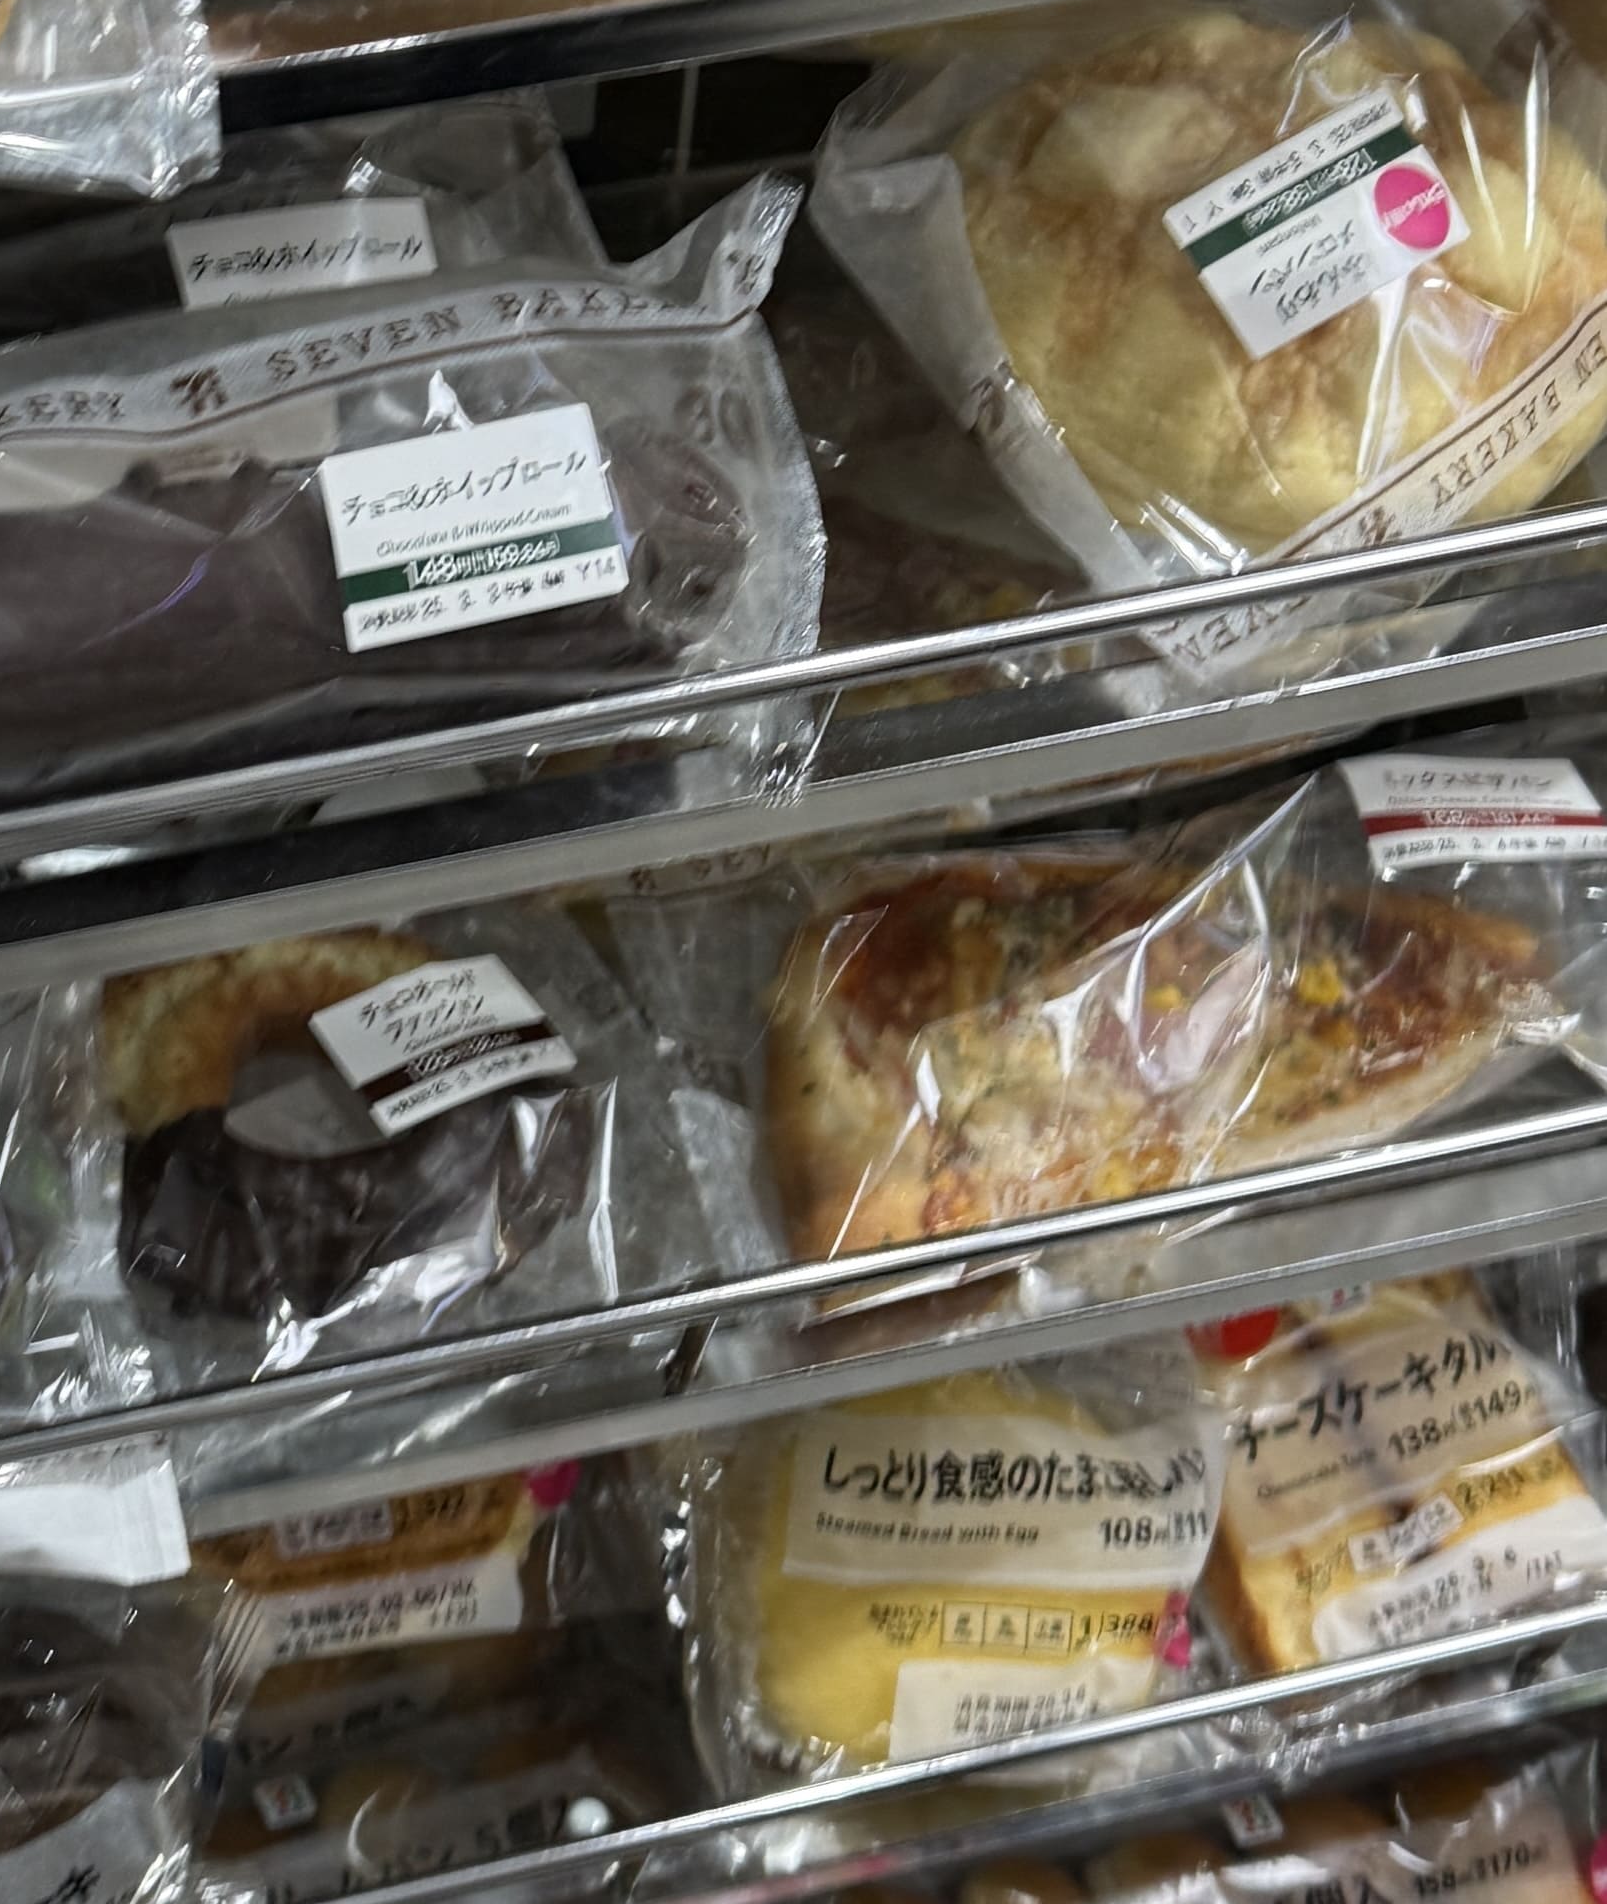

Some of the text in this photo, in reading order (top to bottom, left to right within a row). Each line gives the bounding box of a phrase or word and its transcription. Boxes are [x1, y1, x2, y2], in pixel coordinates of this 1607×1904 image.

[1249, 220, 1357, 295] メロンパン
[1276, 253, 1369, 325] ふんわり
[266, 303, 463, 383] SEVEN
[815, 1511, 1041, 1545] Steamed Bread with Egg
